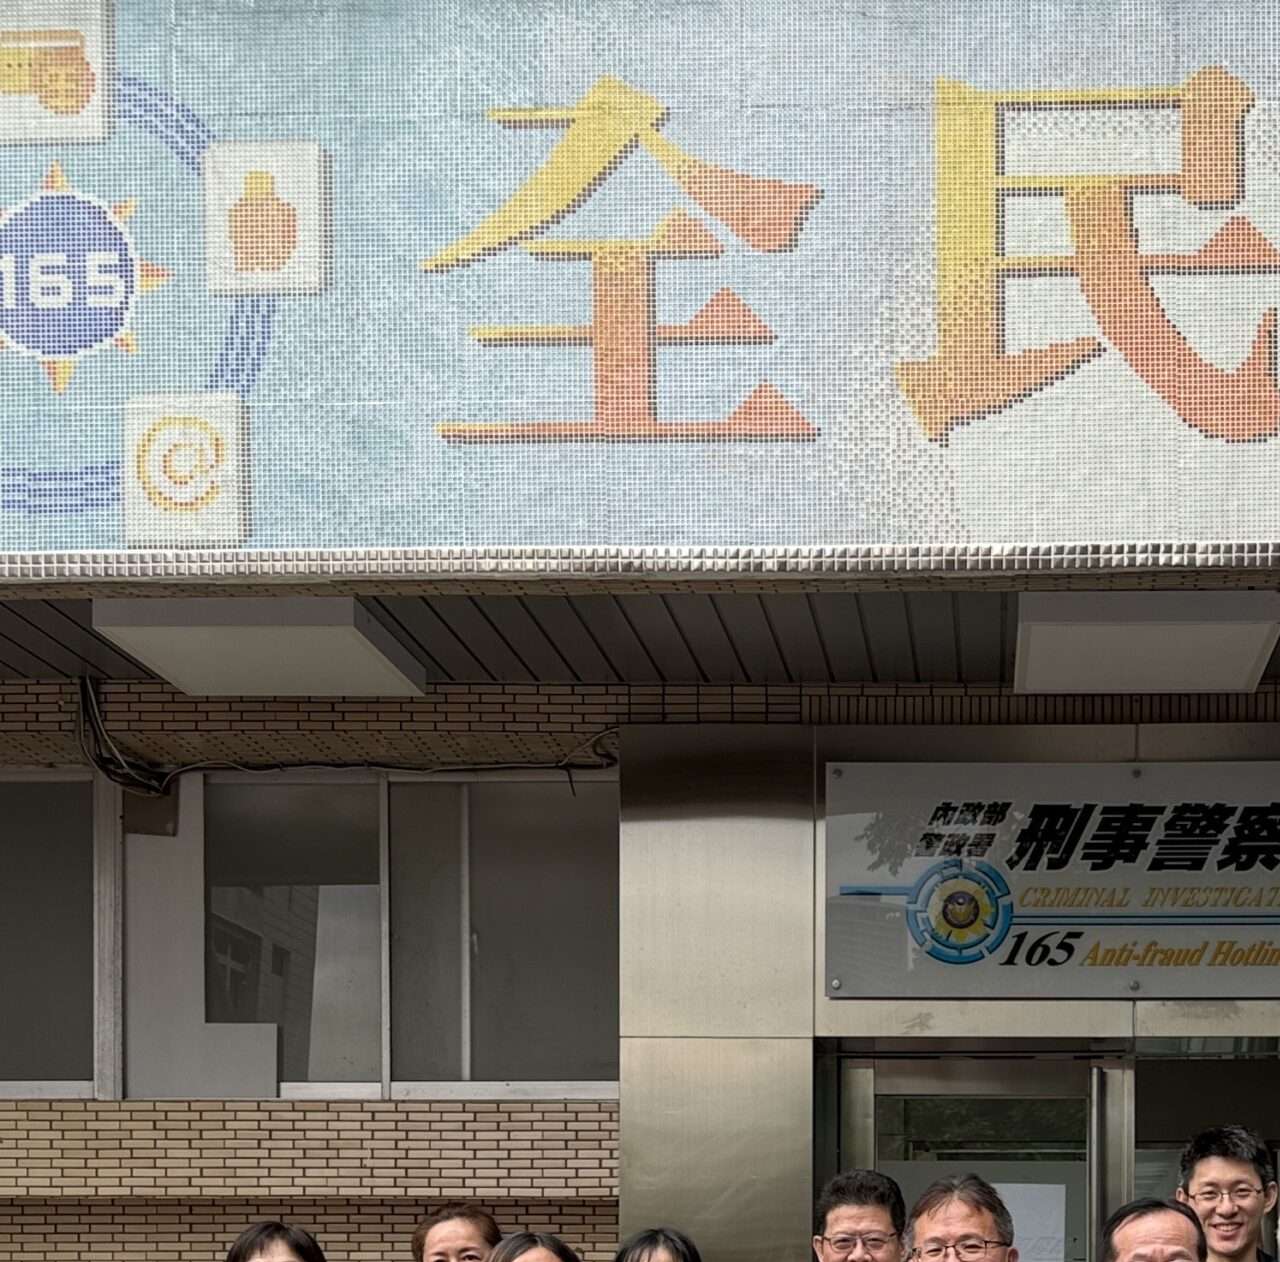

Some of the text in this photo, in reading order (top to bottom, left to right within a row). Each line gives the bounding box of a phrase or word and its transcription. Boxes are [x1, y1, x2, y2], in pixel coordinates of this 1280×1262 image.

[0, 251, 126, 308] 165
[1019, 886, 1131, 909] CRIMINAL
[1001, 930, 1085, 968] 165
[1080, 940, 1210, 968] Anti-fraud
